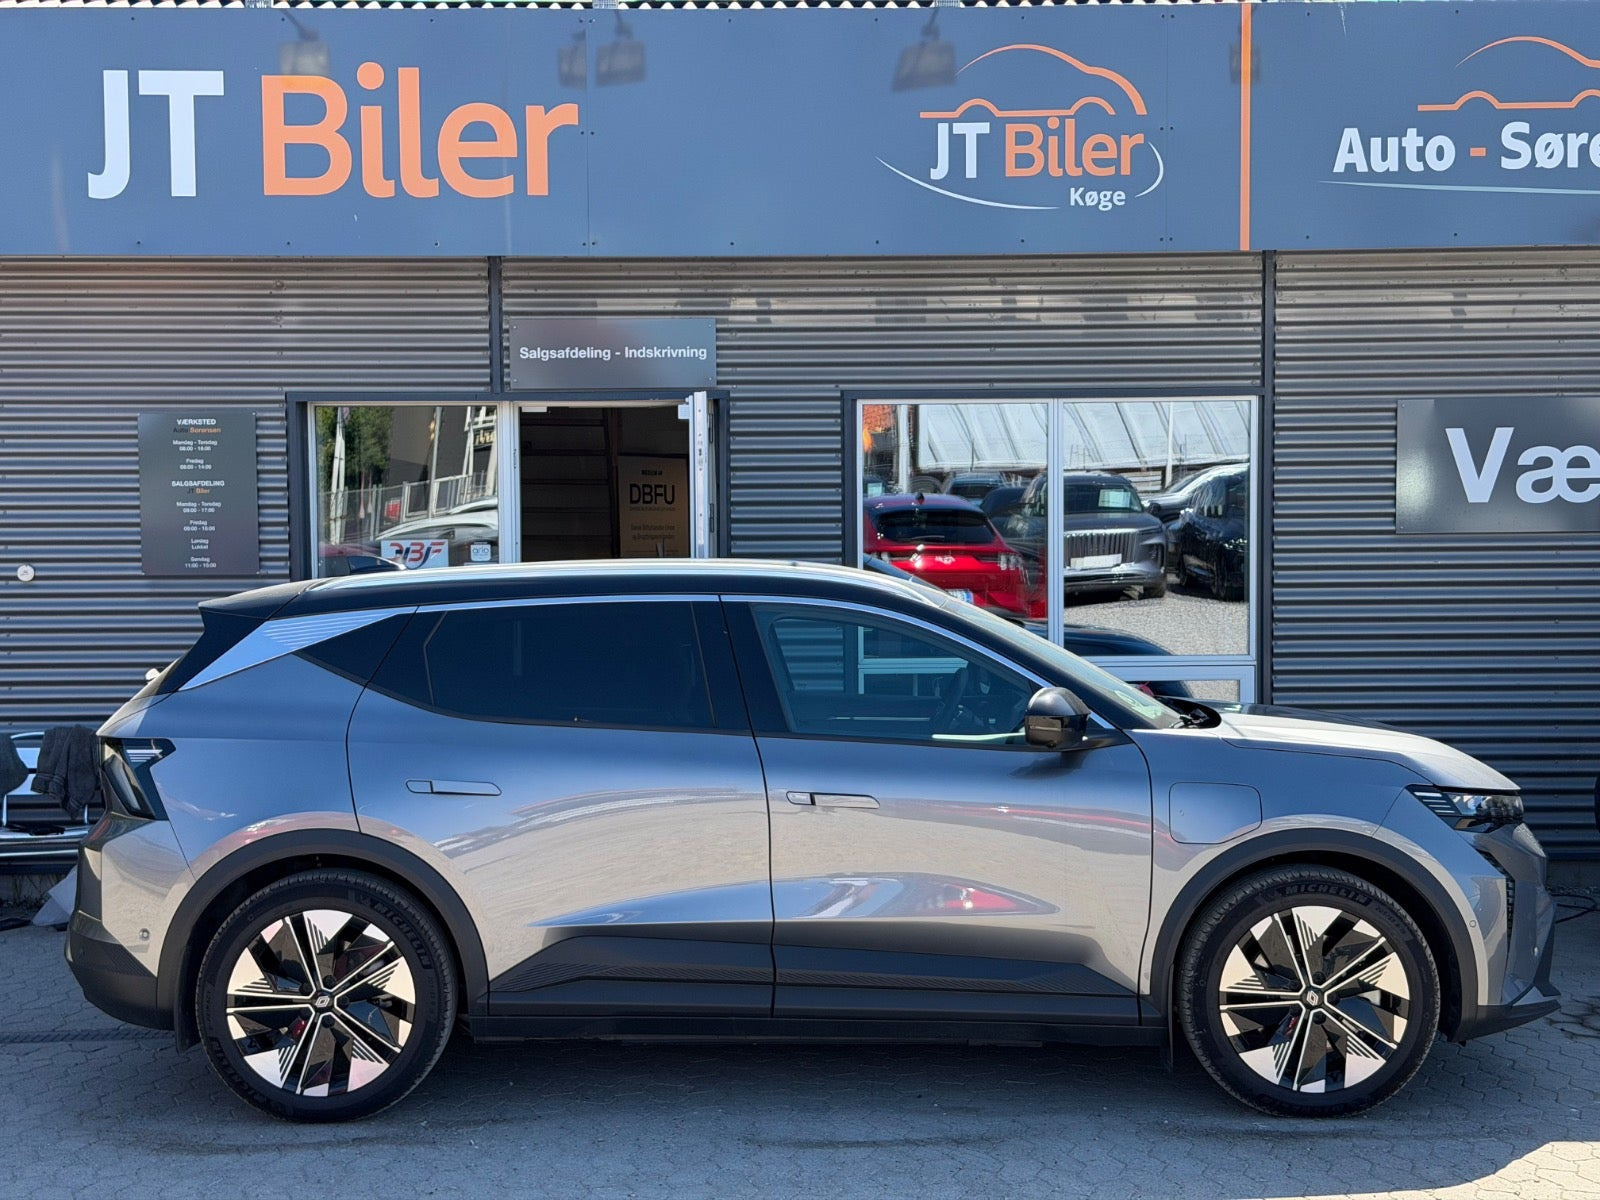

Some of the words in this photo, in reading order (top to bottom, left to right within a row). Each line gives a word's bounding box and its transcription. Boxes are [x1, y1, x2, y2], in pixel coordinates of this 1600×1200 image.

[88, 69, 225, 199] JT
[261, 61, 579, 198] Biler
[930, 121, 990, 180] JT
[1005, 116, 1145, 177] Biler
[1332, 127, 1456, 173] Auto
[1069, 187, 1126, 211] Køge
[519, 346, 611, 362] Salgsafdeling
[624, 345, 708, 360] Indskrivning
[176, 418, 217, 426] VÆRKSTED
[629, 483, 675, 505] DBFU
[1285, 883, 1368, 904] MICHELIN
